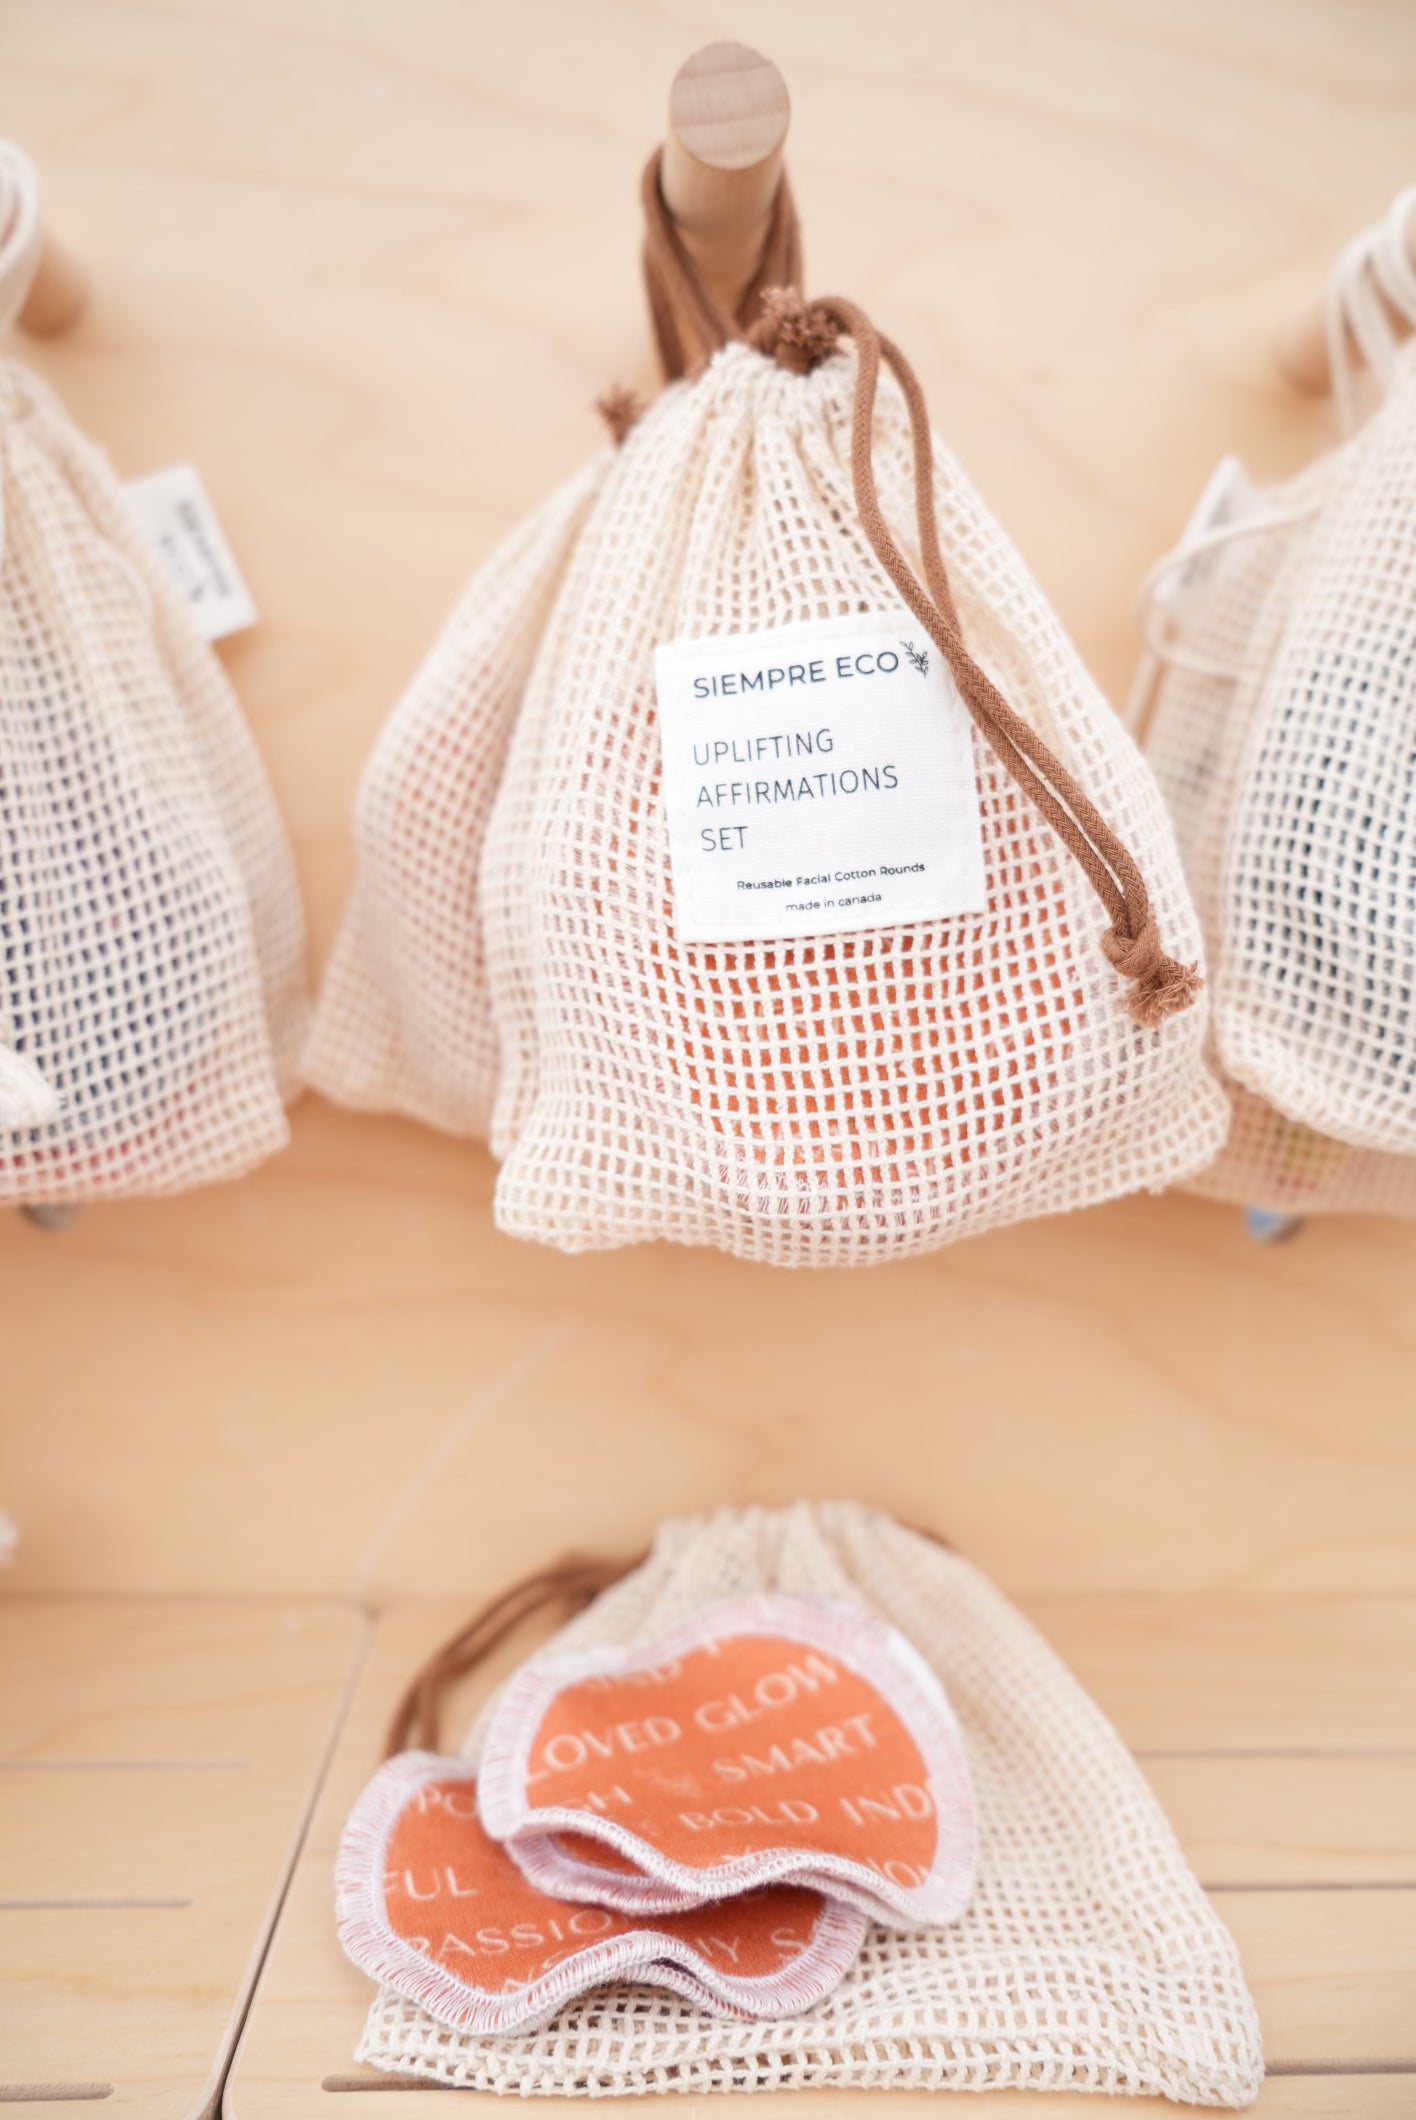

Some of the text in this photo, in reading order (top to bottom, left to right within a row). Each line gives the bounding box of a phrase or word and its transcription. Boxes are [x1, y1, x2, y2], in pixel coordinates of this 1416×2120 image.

[693, 651, 900, 698] SIEMPRE ECO
[693, 728, 834, 766] UPLIFTING
[696, 765, 899, 808] AFFIRMATIONS
[700, 825, 748, 852] SET
[736, 862, 926, 891] Reusable Facial Cotton Rounds
[785, 892, 882, 912] made in canada
[712, 1713, 878, 1772] SMART
[677, 1800, 820, 1831] BOLD
